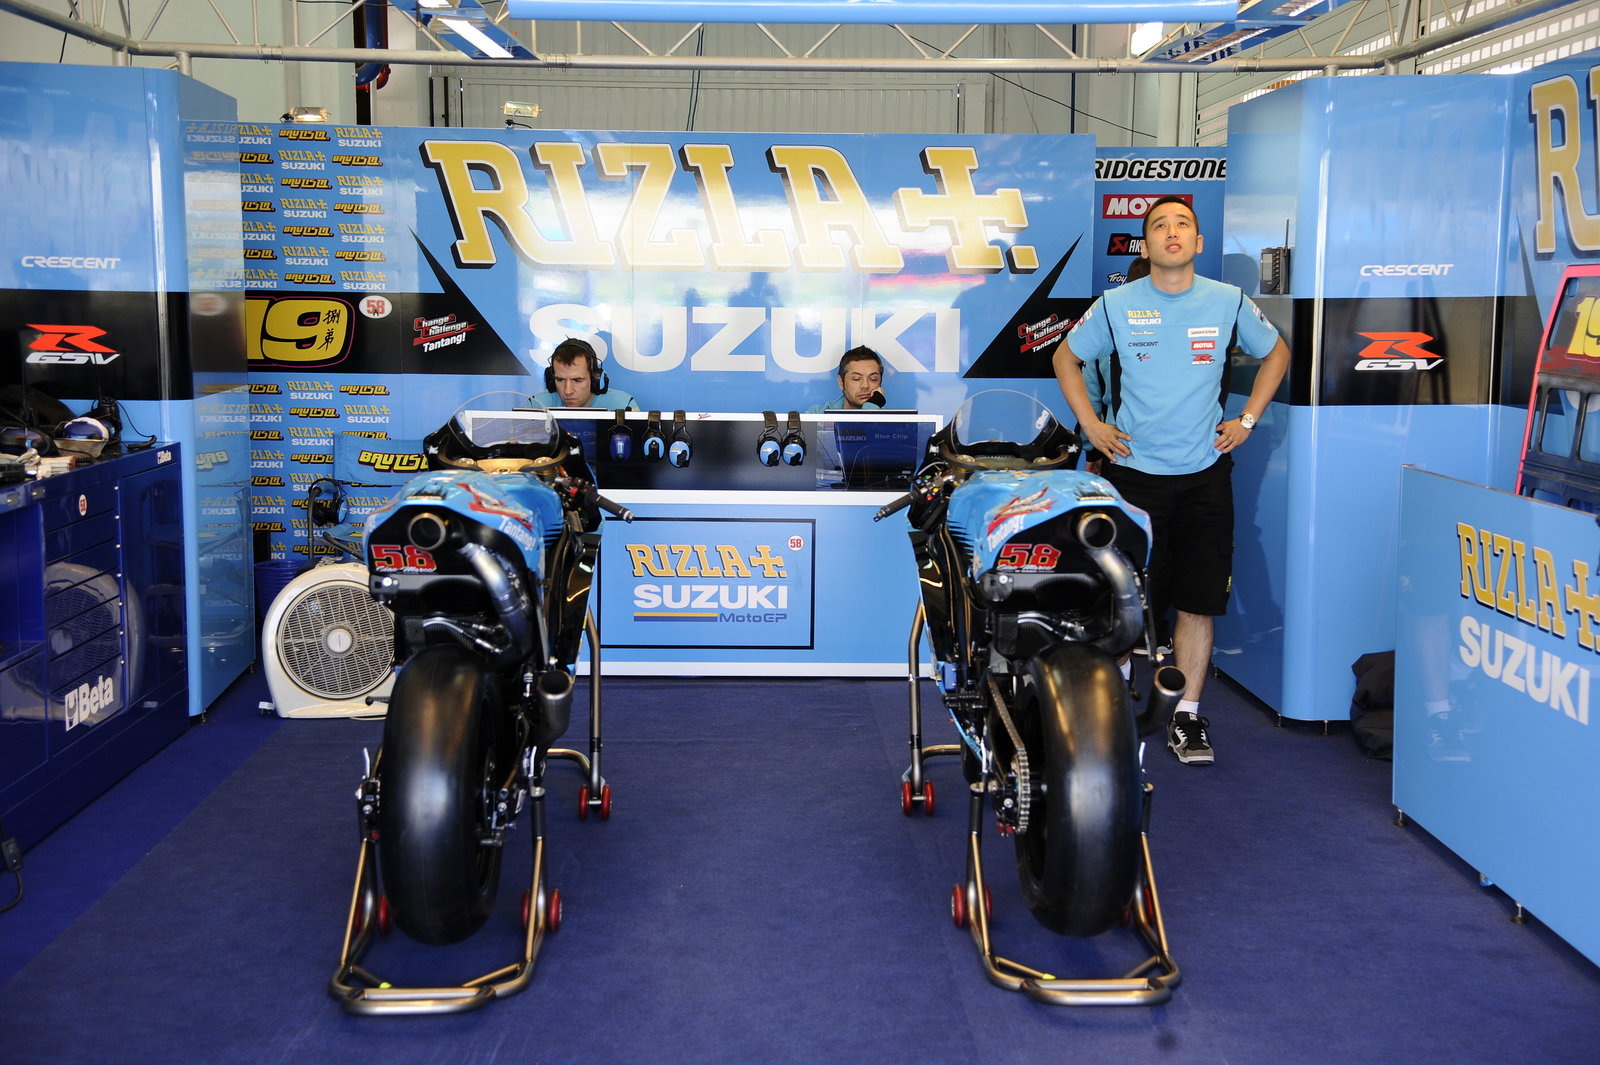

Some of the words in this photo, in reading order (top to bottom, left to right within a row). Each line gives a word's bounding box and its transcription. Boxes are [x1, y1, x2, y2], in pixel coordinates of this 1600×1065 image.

[239, 136, 272, 144] UZUKI
[338, 138, 382, 147] SUZUKI
[282, 161, 325, 170] SUZUKI
[1095, 158, 1226, 180] RIDGESTONE
[241, 184, 274, 192] UZUKI
[340, 187, 383, 195] SUZUKI
[284, 209, 327, 218] SUZUKI
[242, 232, 276, 240] UZUKI
[342, 234, 385, 242] SUZUKI
[21, 255, 121, 270] CRESCENT
[286, 257, 329, 265] SUZUKI
[1359, 263, 1455, 277] CRESCENT
[245, 280, 278, 288] UZUKI
[366, 300, 386, 315] 58
[421, 321, 468, 338] Challenge
[422, 331, 467, 353] Tantang!
[528, 304, 960, 374] SUZUKI
[347, 415, 390, 423] SUZUKI
[292, 438, 334, 446] SUZUKI
[251, 460, 284, 468] UZUKI
[252, 506, 285, 514] UZUKI
[789, 537, 803, 550] 58
[371, 544, 437, 571] 58
[997, 543, 1062, 568] 58
[633, 584, 788, 610] SUZUKI
[719, 612, 788, 624] MotoGP
[1458, 615, 1591, 726] SUZUKI
